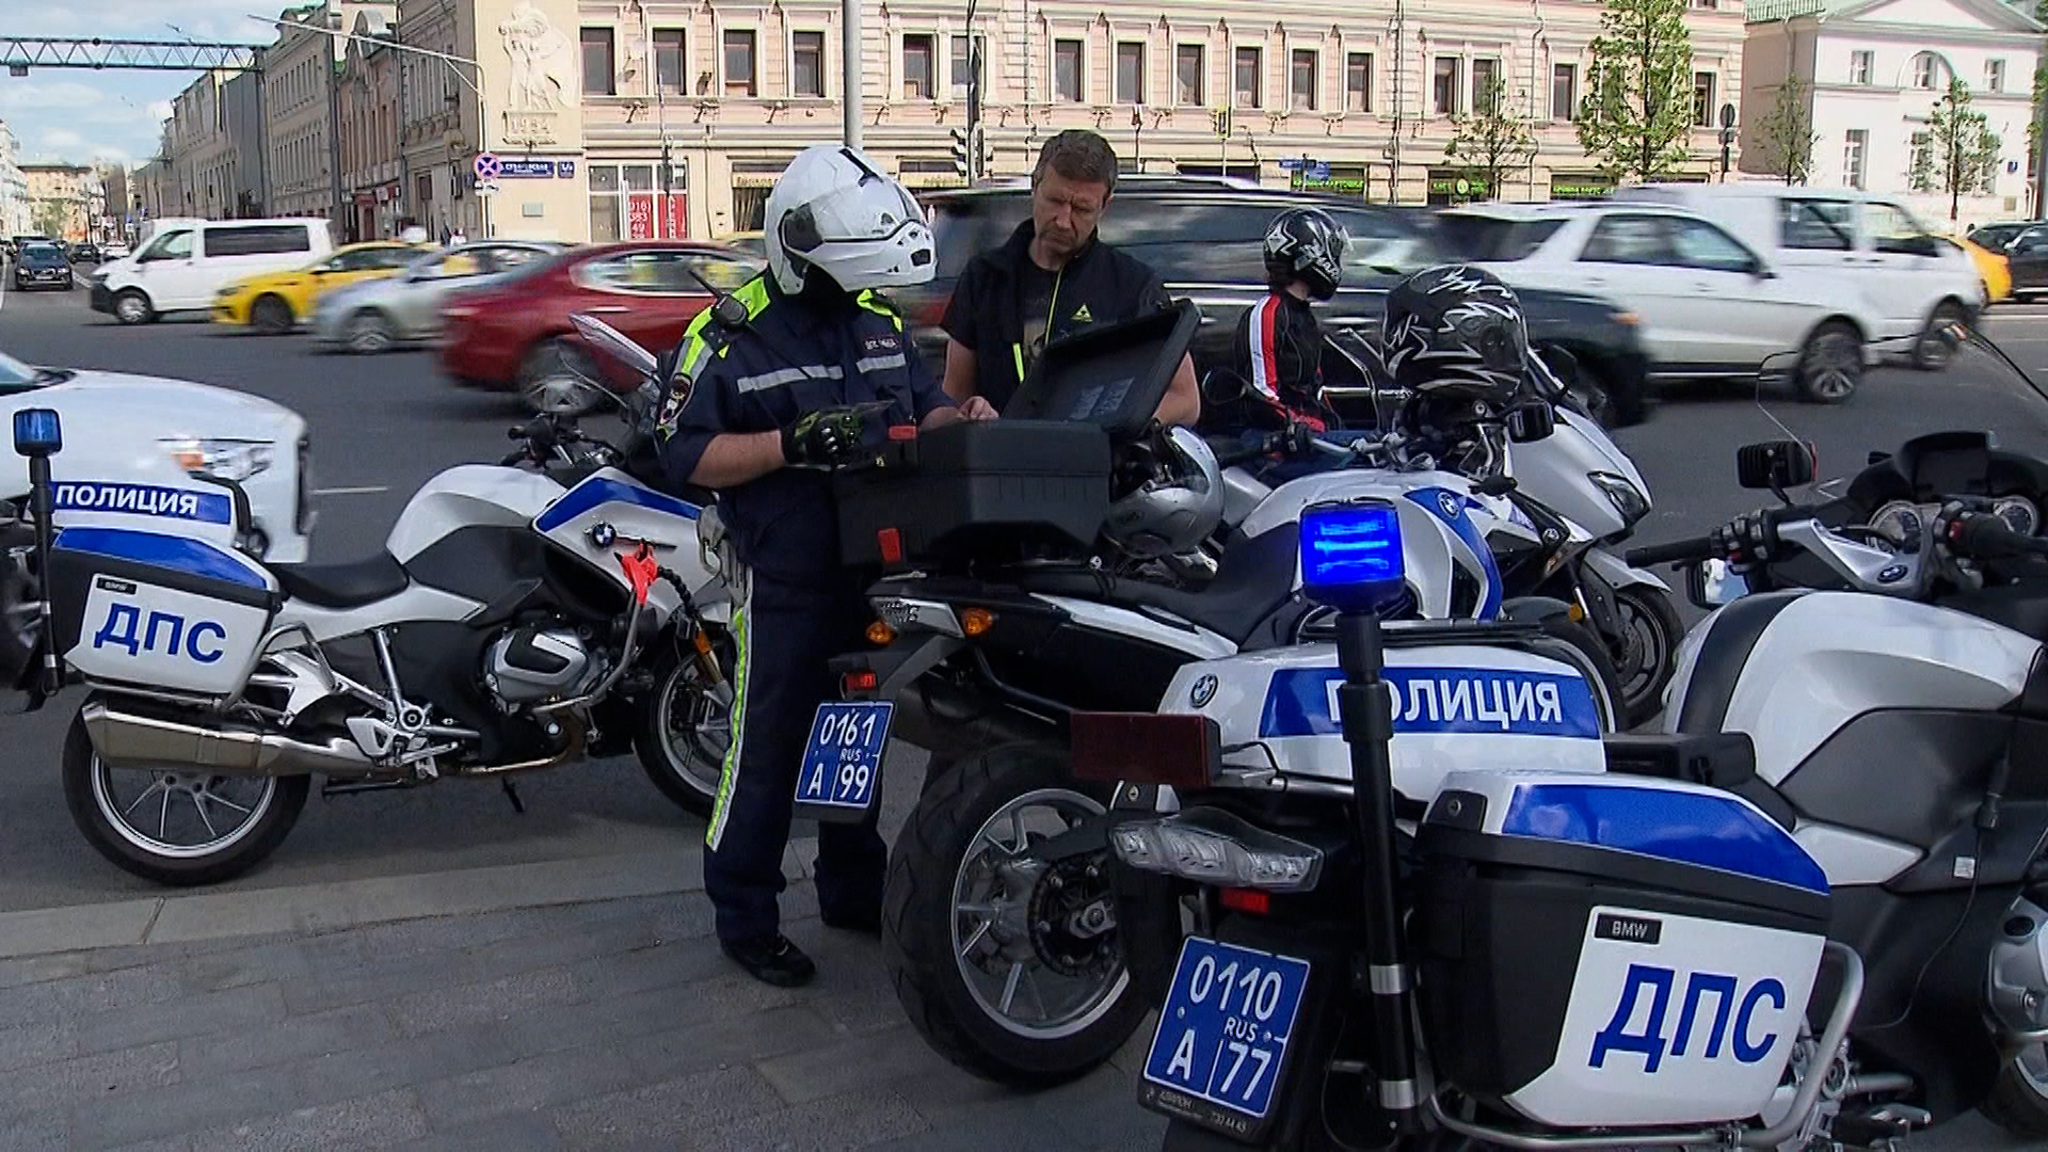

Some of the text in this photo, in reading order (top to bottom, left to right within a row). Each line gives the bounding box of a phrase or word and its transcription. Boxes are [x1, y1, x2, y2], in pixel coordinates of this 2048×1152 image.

[55, 484, 199, 516] ПОЛИЦИЯ
[93, 602, 227, 664] ДПС
[820, 712, 877, 746] 0161
[840, 748, 863, 761] RUS
[840, 764, 869, 800] 99
[1611, 920, 1649, 938] BMW
[1189, 955, 1283, 1021] 0110
[1223, 1016, 1259, 1042] RUS
[1588, 963, 1786, 1073] ДПС
[1219, 1041, 1272, 1101] 77
